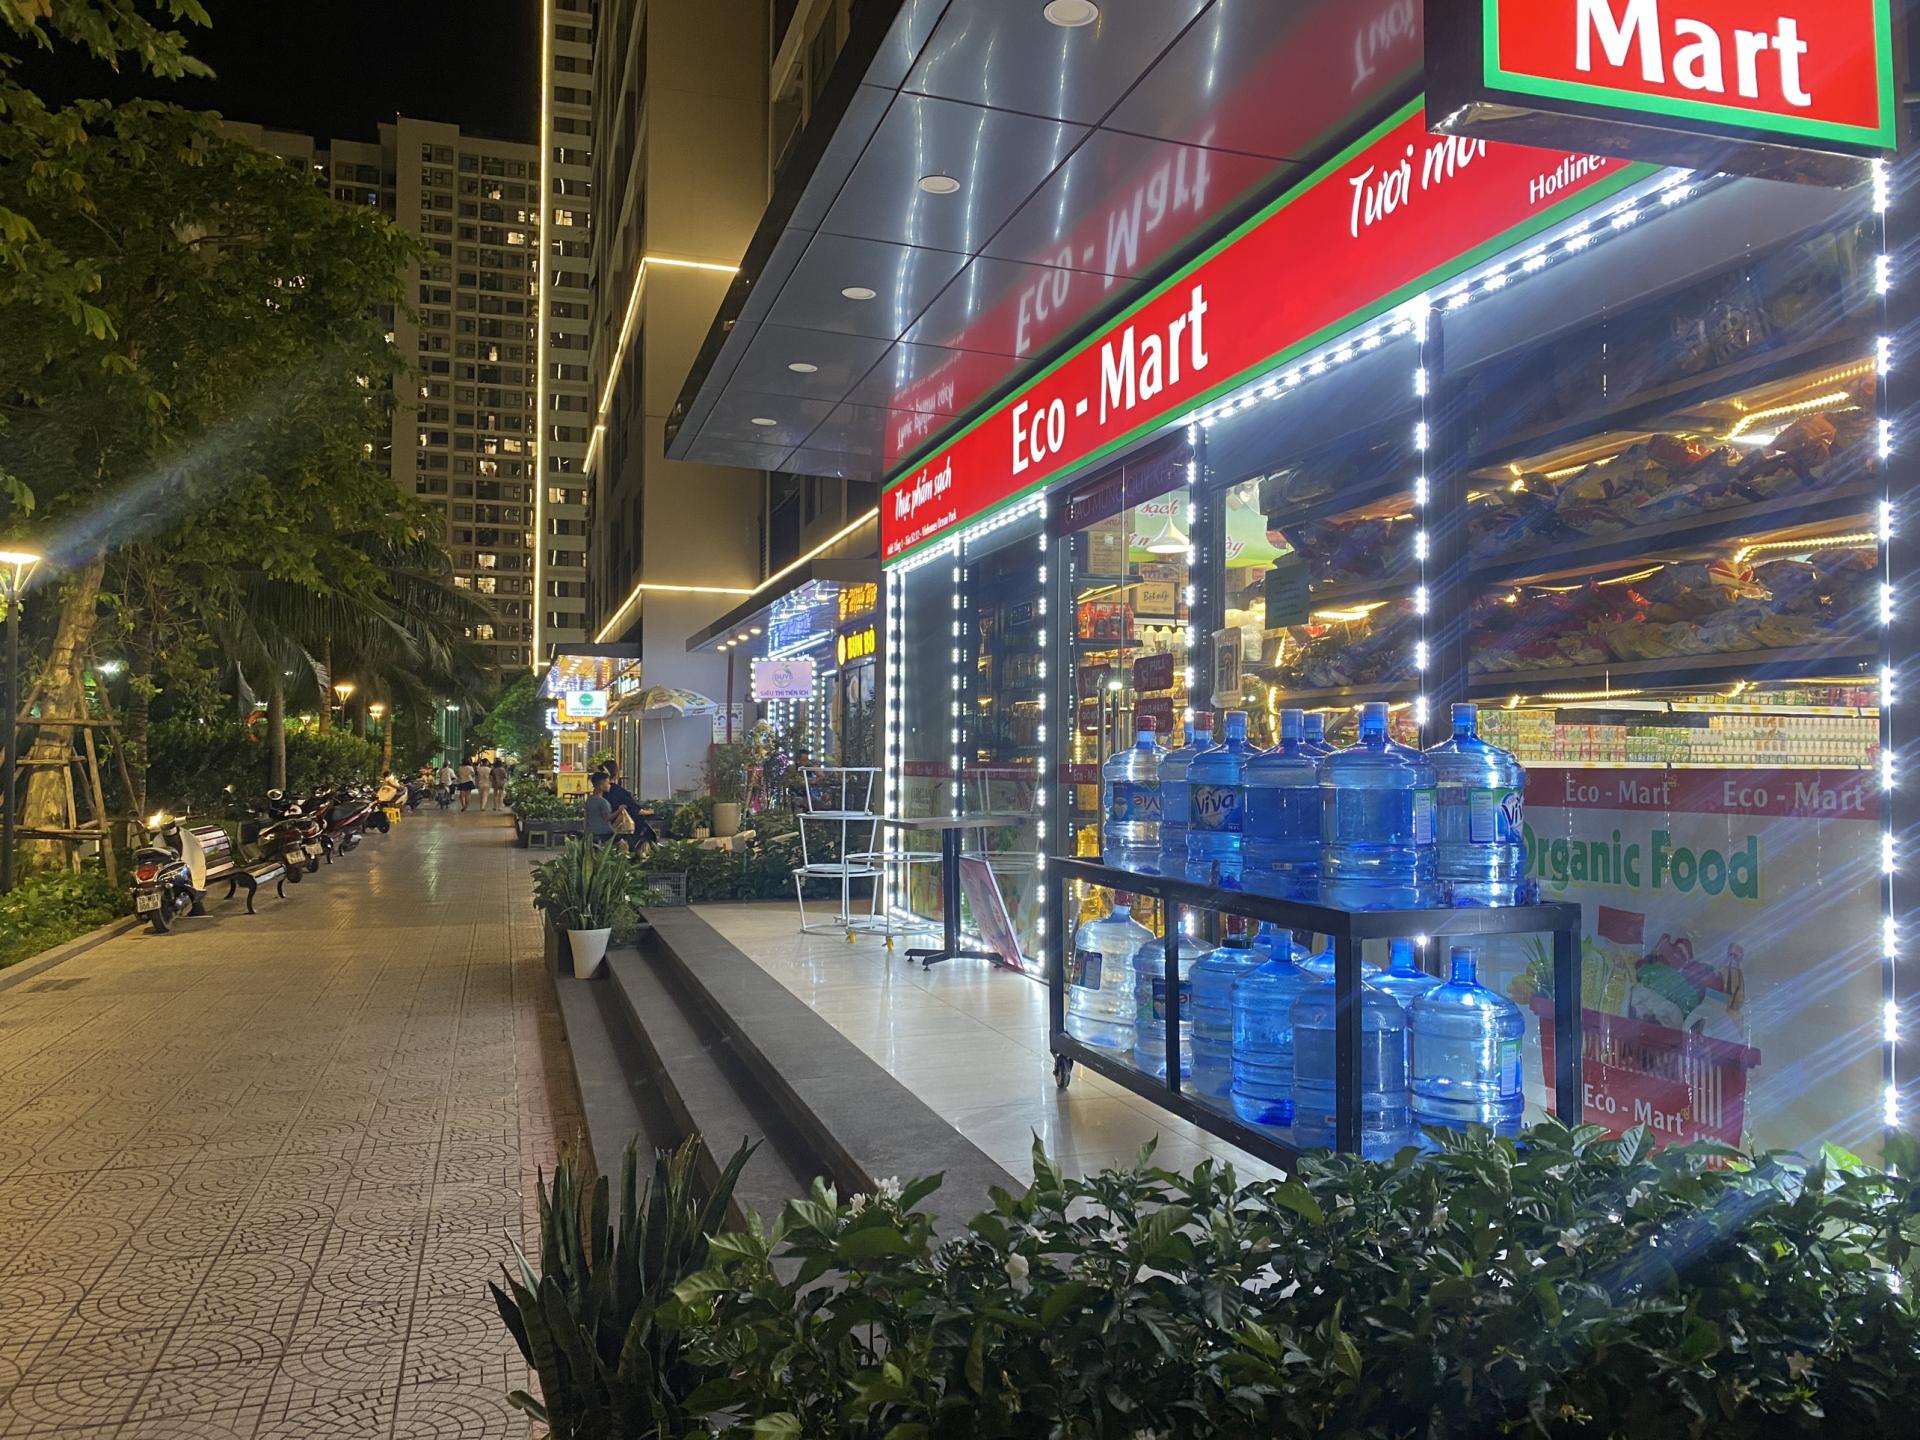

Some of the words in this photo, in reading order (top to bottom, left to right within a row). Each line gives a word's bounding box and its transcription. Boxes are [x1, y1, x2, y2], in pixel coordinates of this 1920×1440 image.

[1575, 0, 1812, 107] Mart
[1012, 398, 1066, 476] Eco
[1099, 283, 1209, 426] Mart
[847, 630, 863, 660] BÚN
[1194, 789, 1235, 815] Viva
[1566, 779, 1598, 803] Eco
[1619, 780, 1671, 806] Mart
[1723, 781, 1768, 807] Eco
[1795, 781, 1865, 812] Mart
[1651, 829, 1759, 899] Food
[1583, 1084, 1616, 1115] Eco
[1634, 1098, 1683, 1136] Mart
